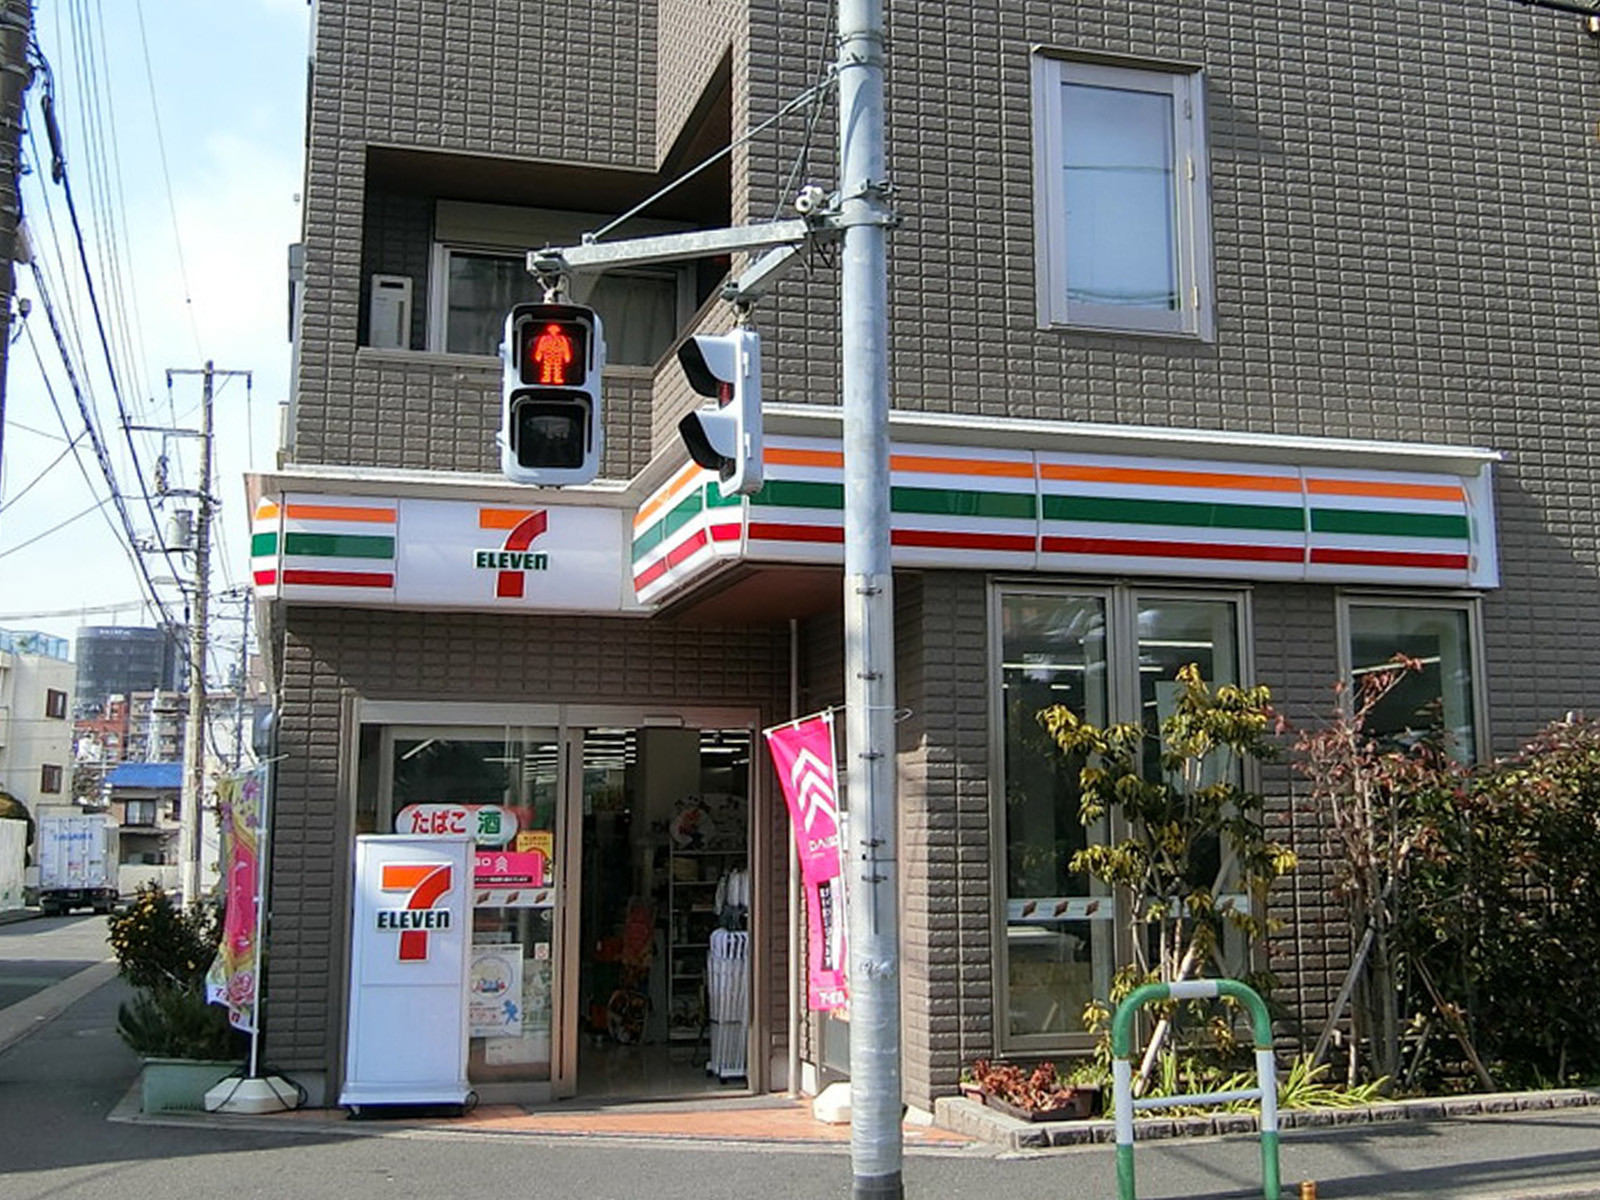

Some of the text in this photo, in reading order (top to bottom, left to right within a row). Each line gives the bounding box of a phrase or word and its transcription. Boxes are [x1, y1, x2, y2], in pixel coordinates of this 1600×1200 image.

[479, 508, 548, 599] 7
[411, 809, 503, 835] たばこ 酒
[381, 864, 452, 961] 7
